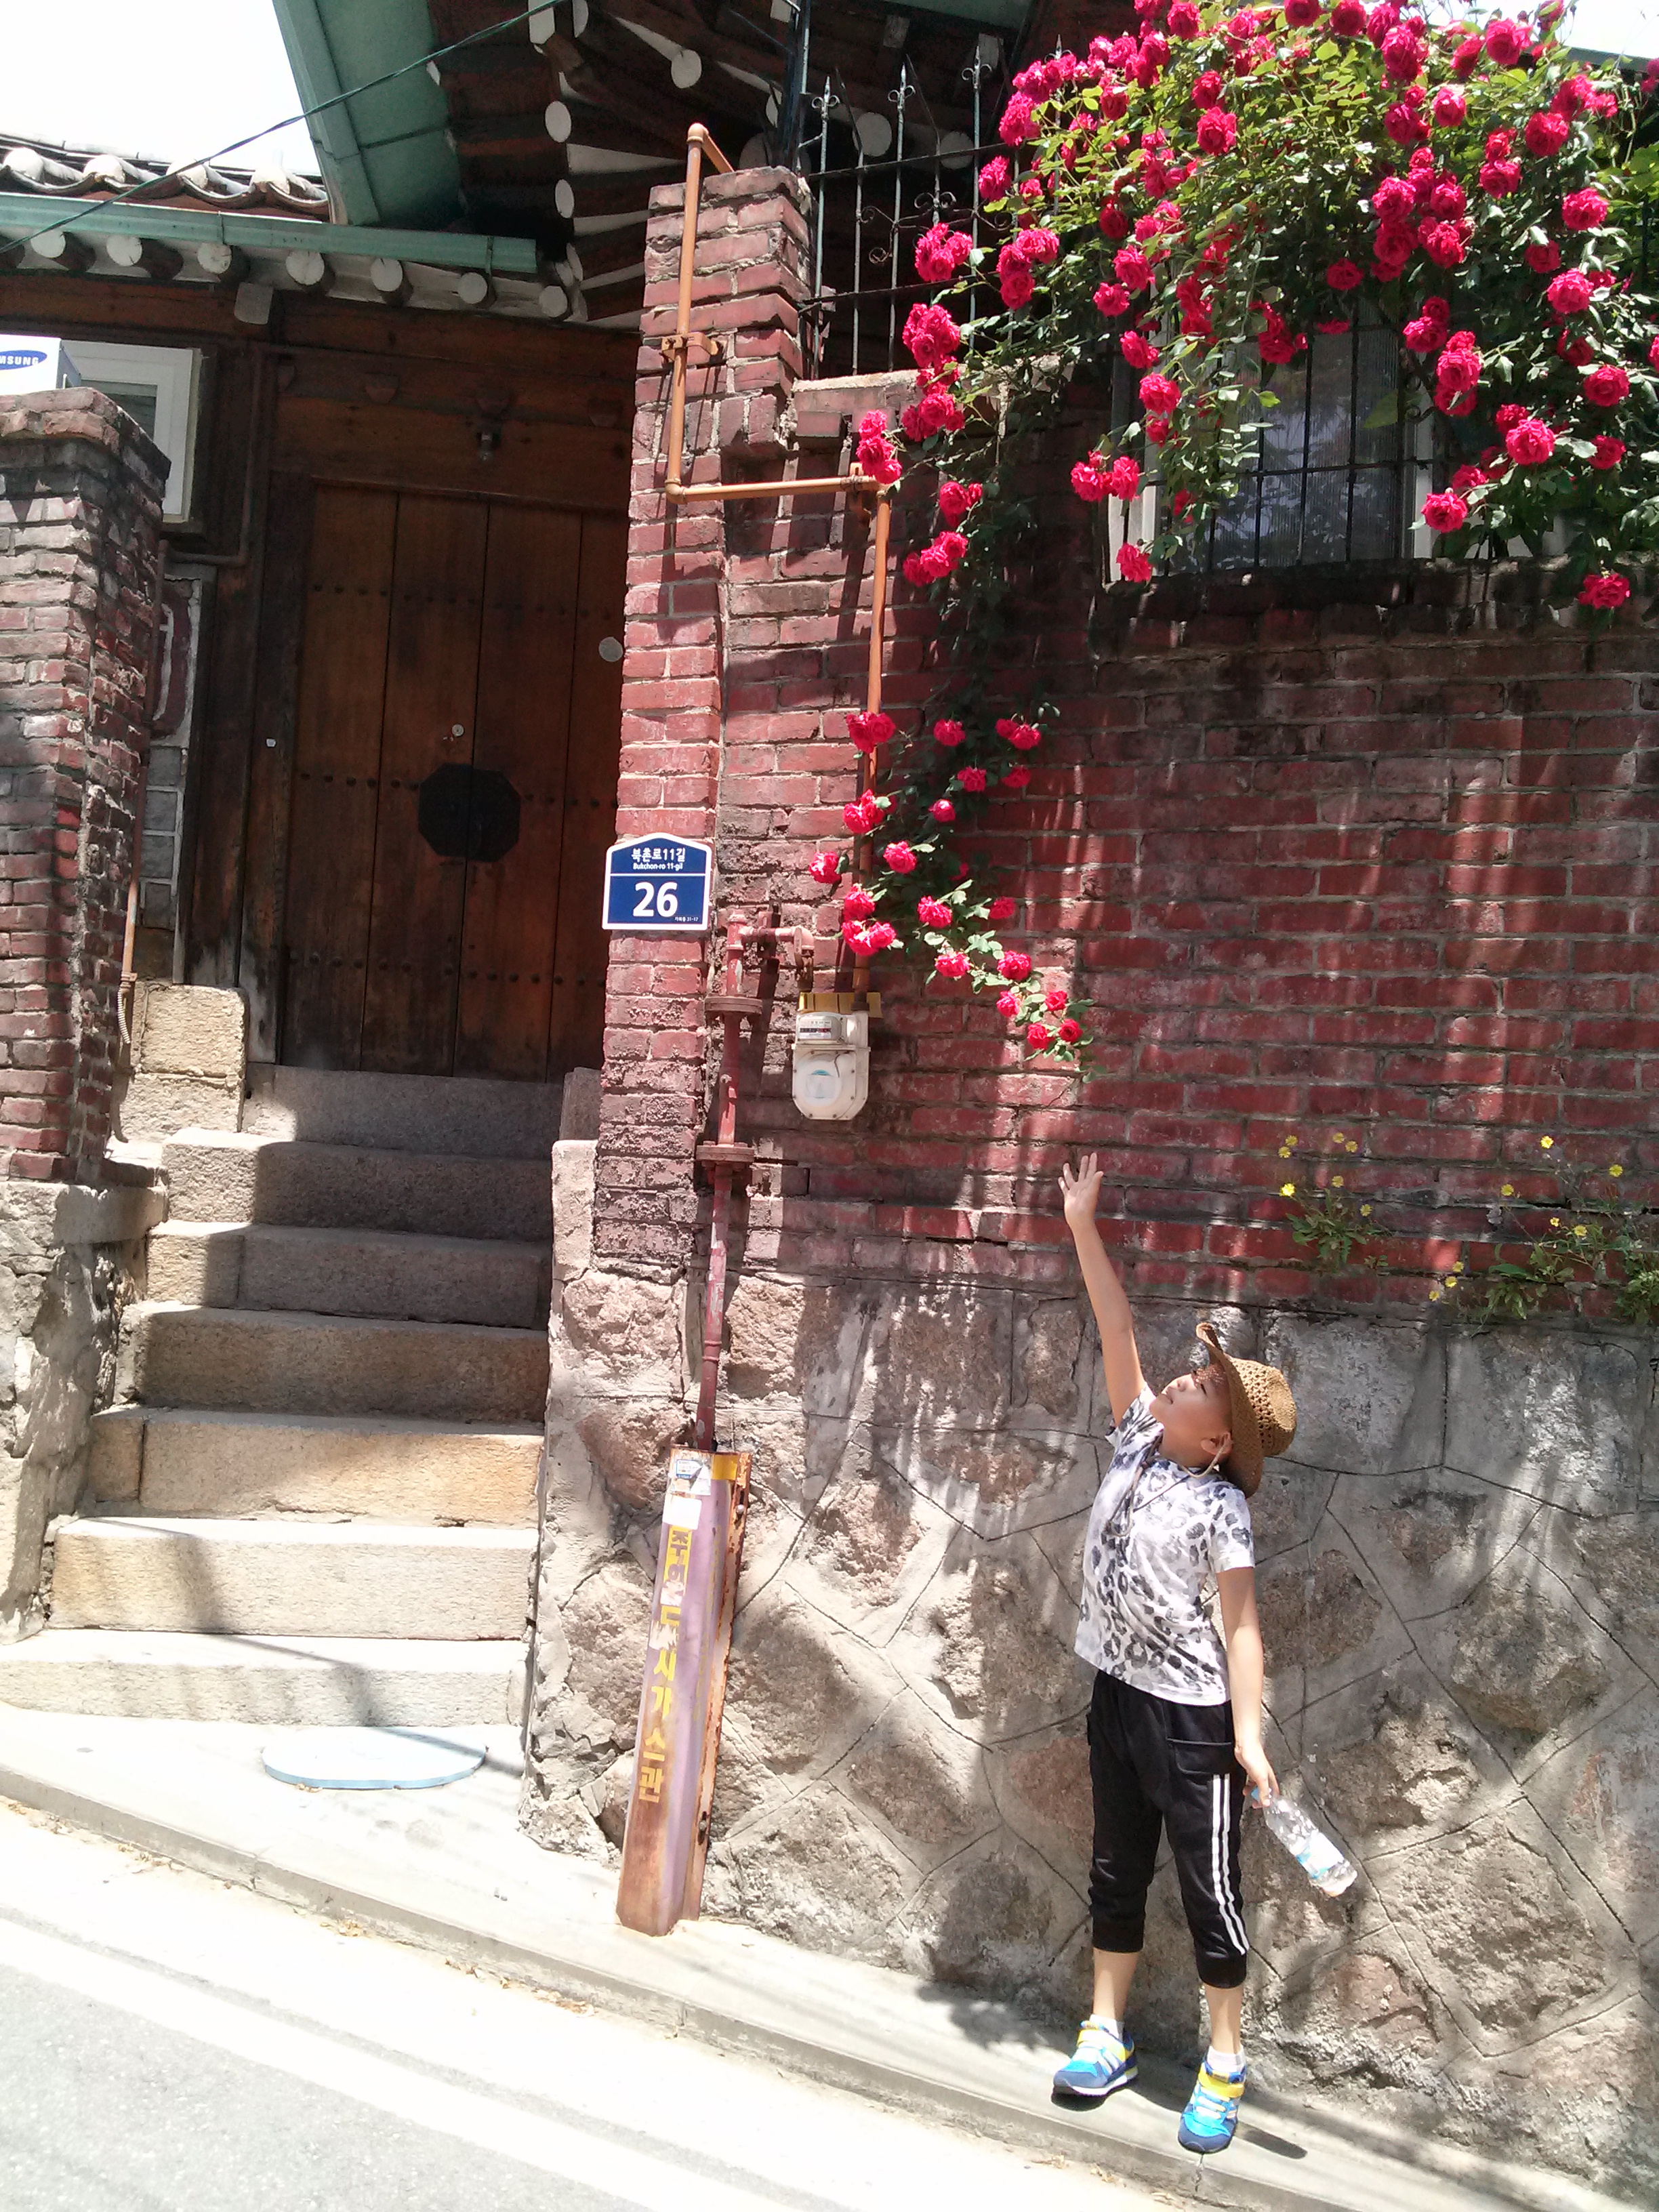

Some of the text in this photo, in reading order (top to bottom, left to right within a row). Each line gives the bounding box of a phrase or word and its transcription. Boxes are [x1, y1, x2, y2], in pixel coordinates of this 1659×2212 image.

[631, 847, 685, 863] 북촌로11길
[633, 862, 683, 872] Bukchon-ro 11-gil
[632, 882, 678, 918] 26
